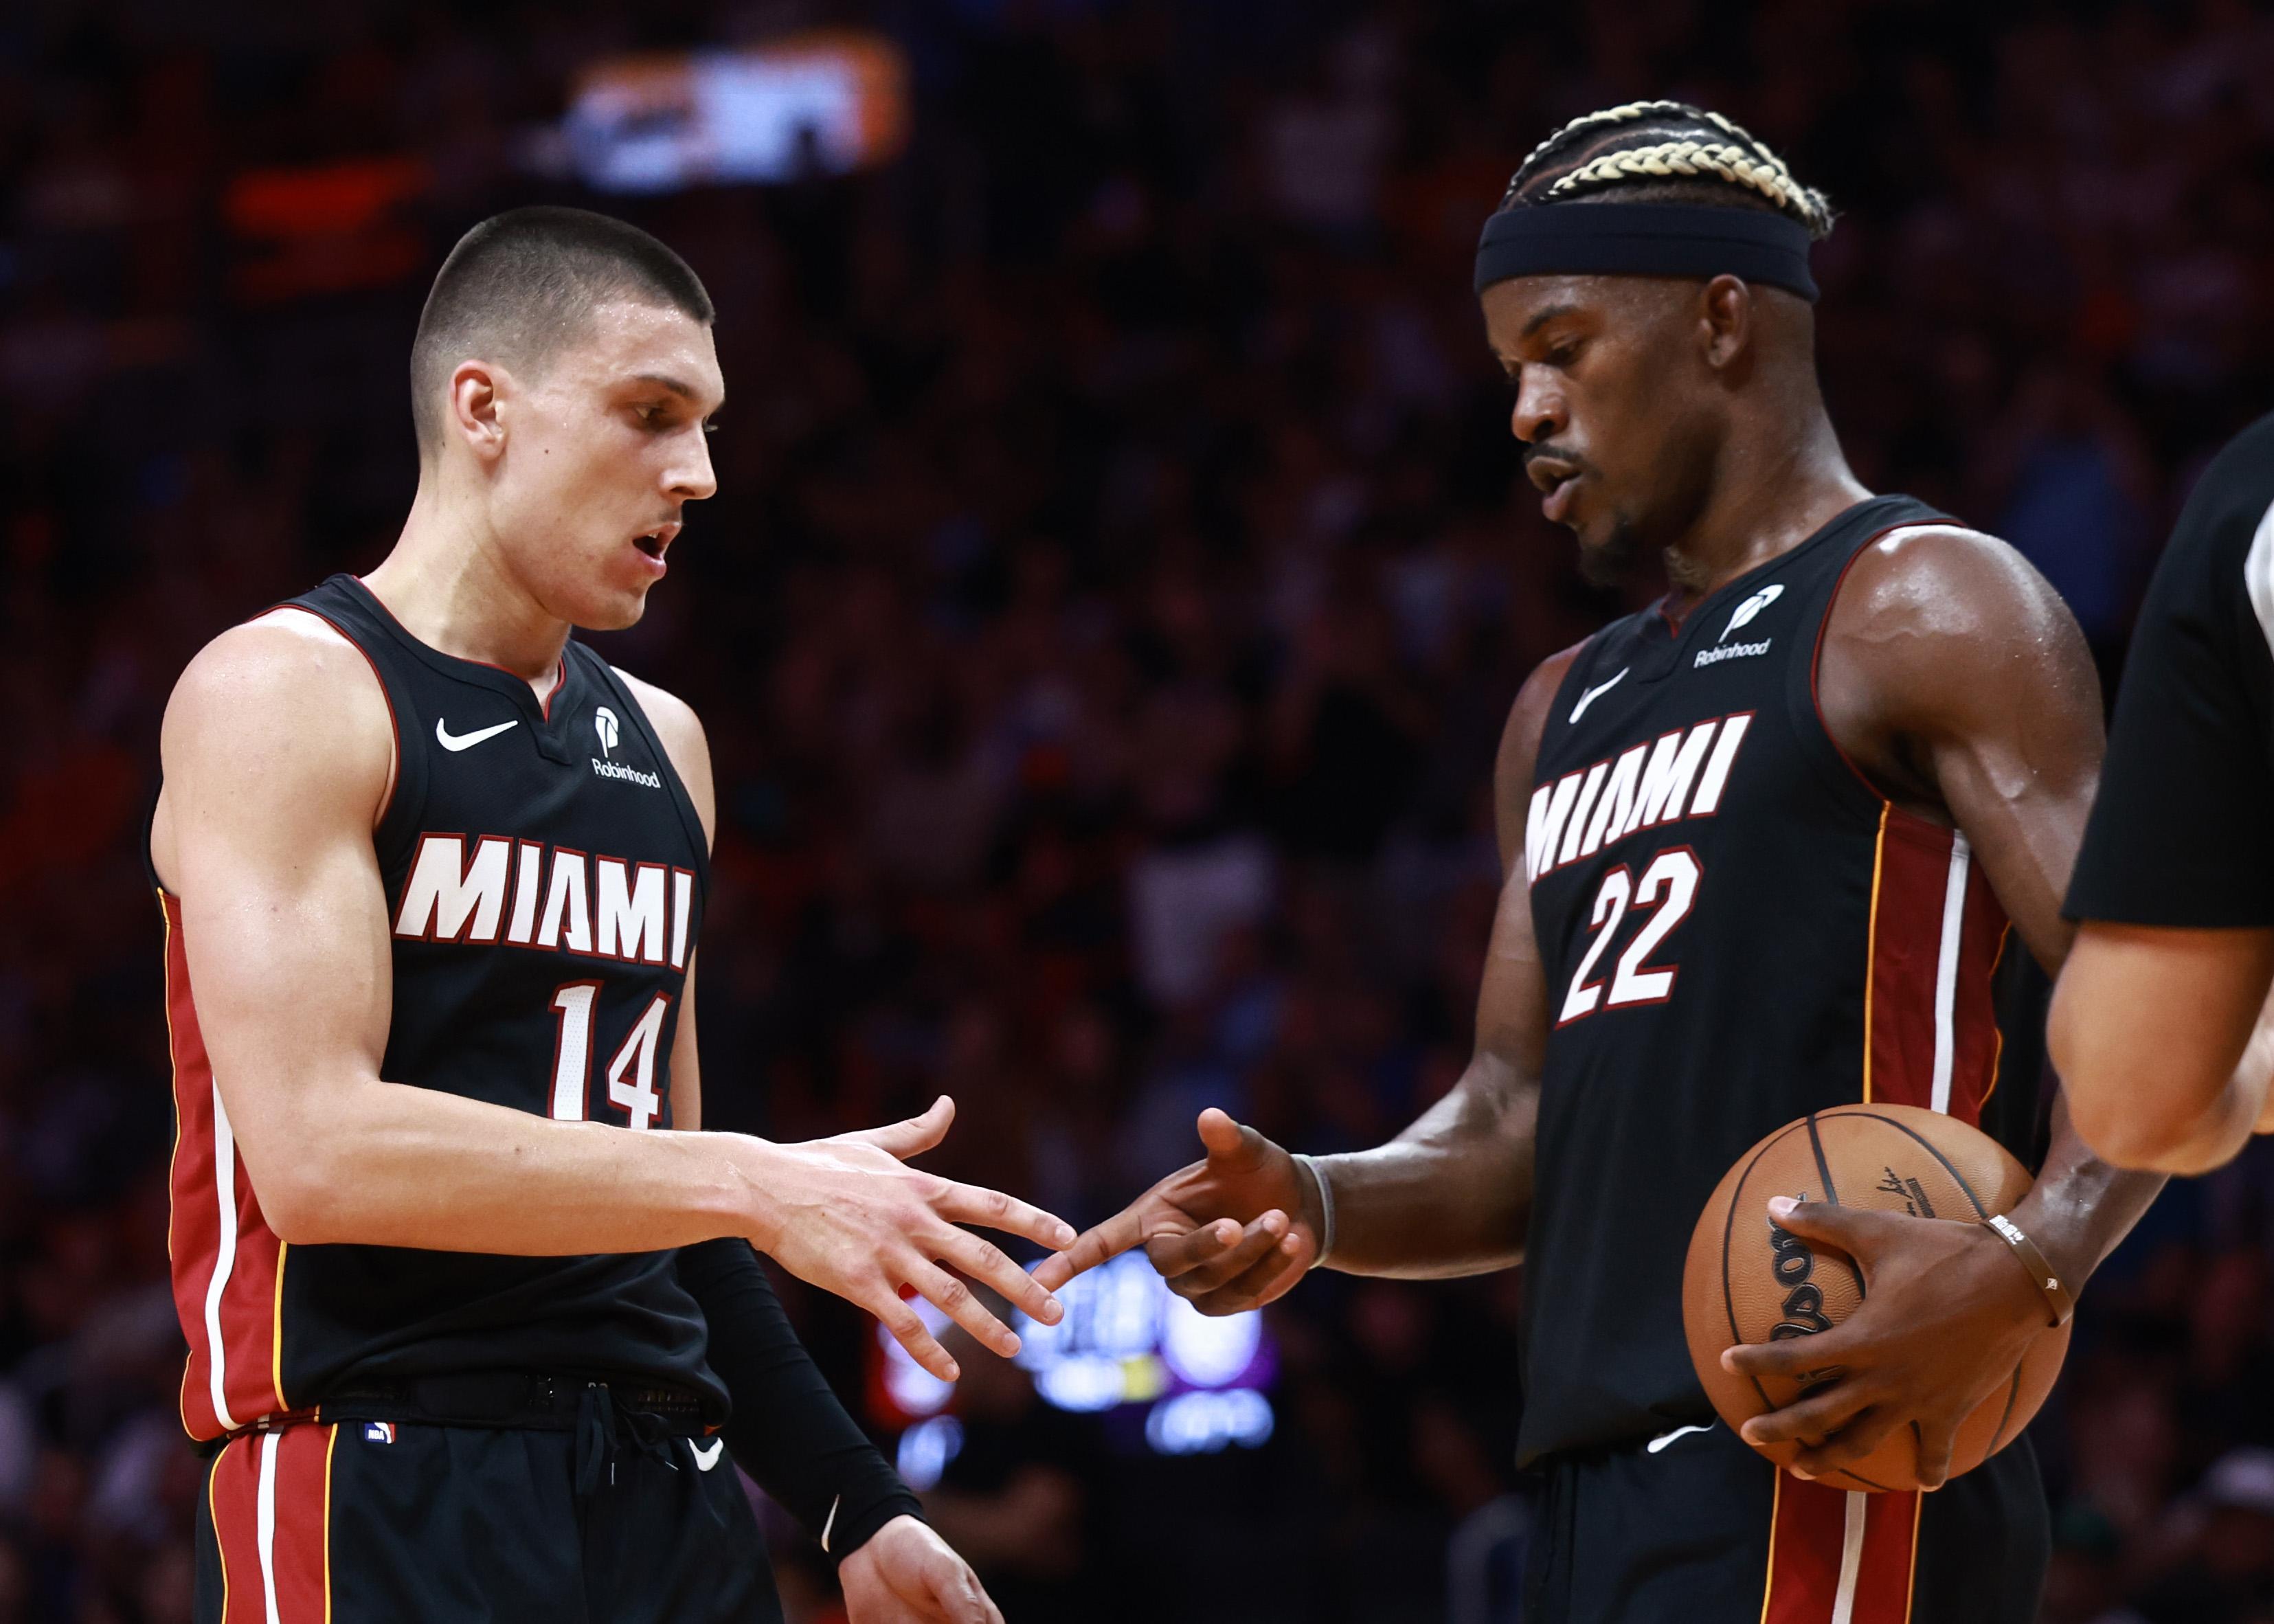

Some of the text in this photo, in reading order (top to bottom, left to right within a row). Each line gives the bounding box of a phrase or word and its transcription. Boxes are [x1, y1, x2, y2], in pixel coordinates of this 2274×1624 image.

[1693, 637, 1772, 668] Robinhood
[592, 758, 661, 789] Robinhood
[1524, 709, 1757, 888] MIAMI
[391, 832, 695, 975] MIAMI
[1555, 844, 1704, 1030] 22
[547, 978, 673, 1131] 14
[368, 1429, 385, 1441] NBA
